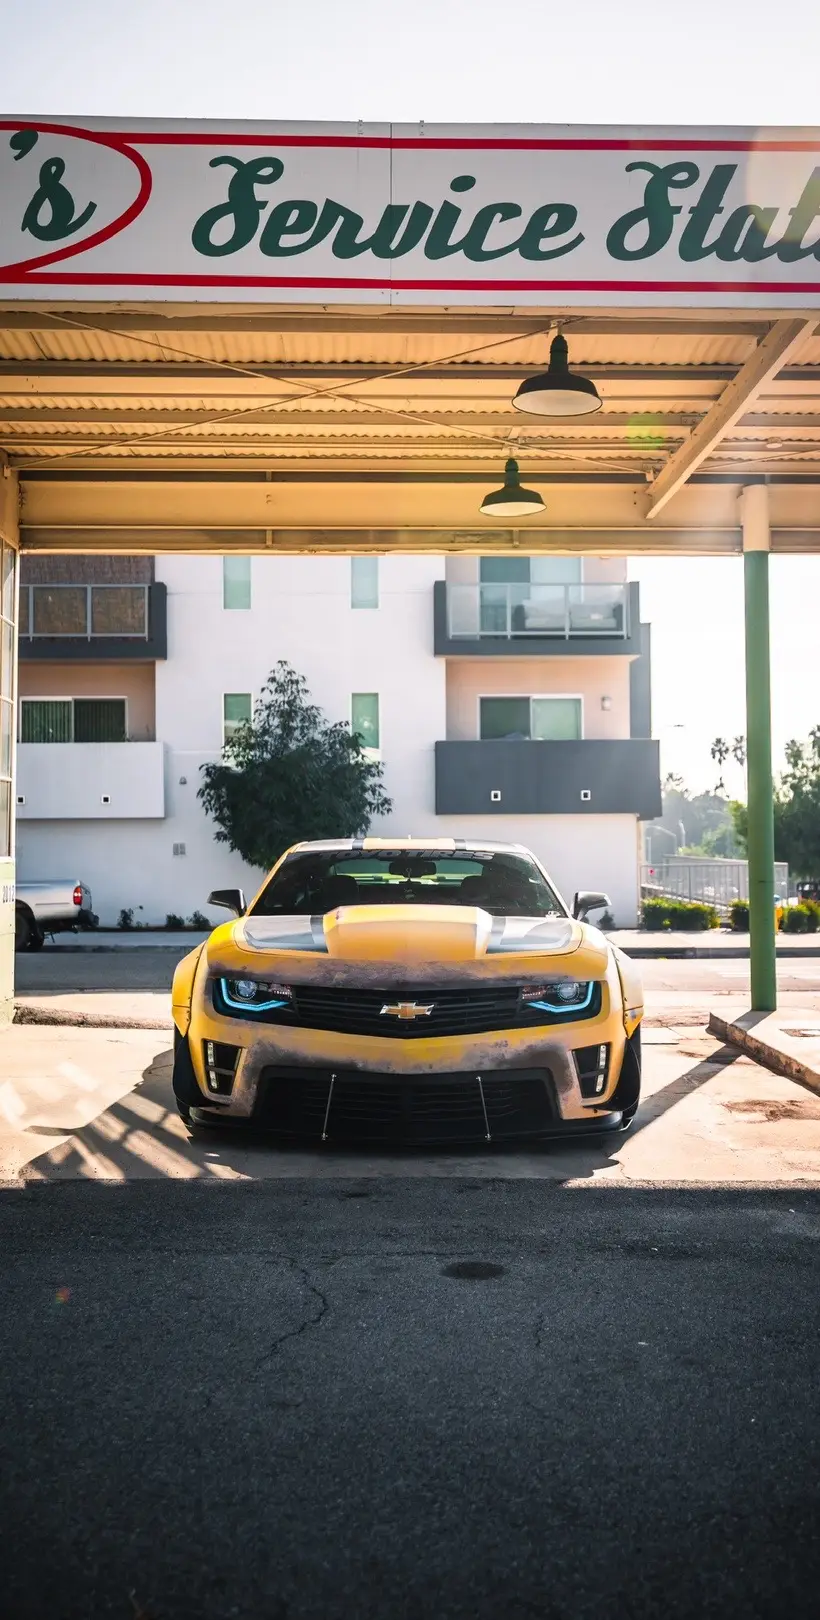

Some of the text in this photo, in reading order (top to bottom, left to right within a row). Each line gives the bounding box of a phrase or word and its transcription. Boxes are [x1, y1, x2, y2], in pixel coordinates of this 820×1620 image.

[191, 155, 586, 262] Service
[606, 161, 820, 263] Stat
[319, 850, 494, 860] TOYO TIRES
